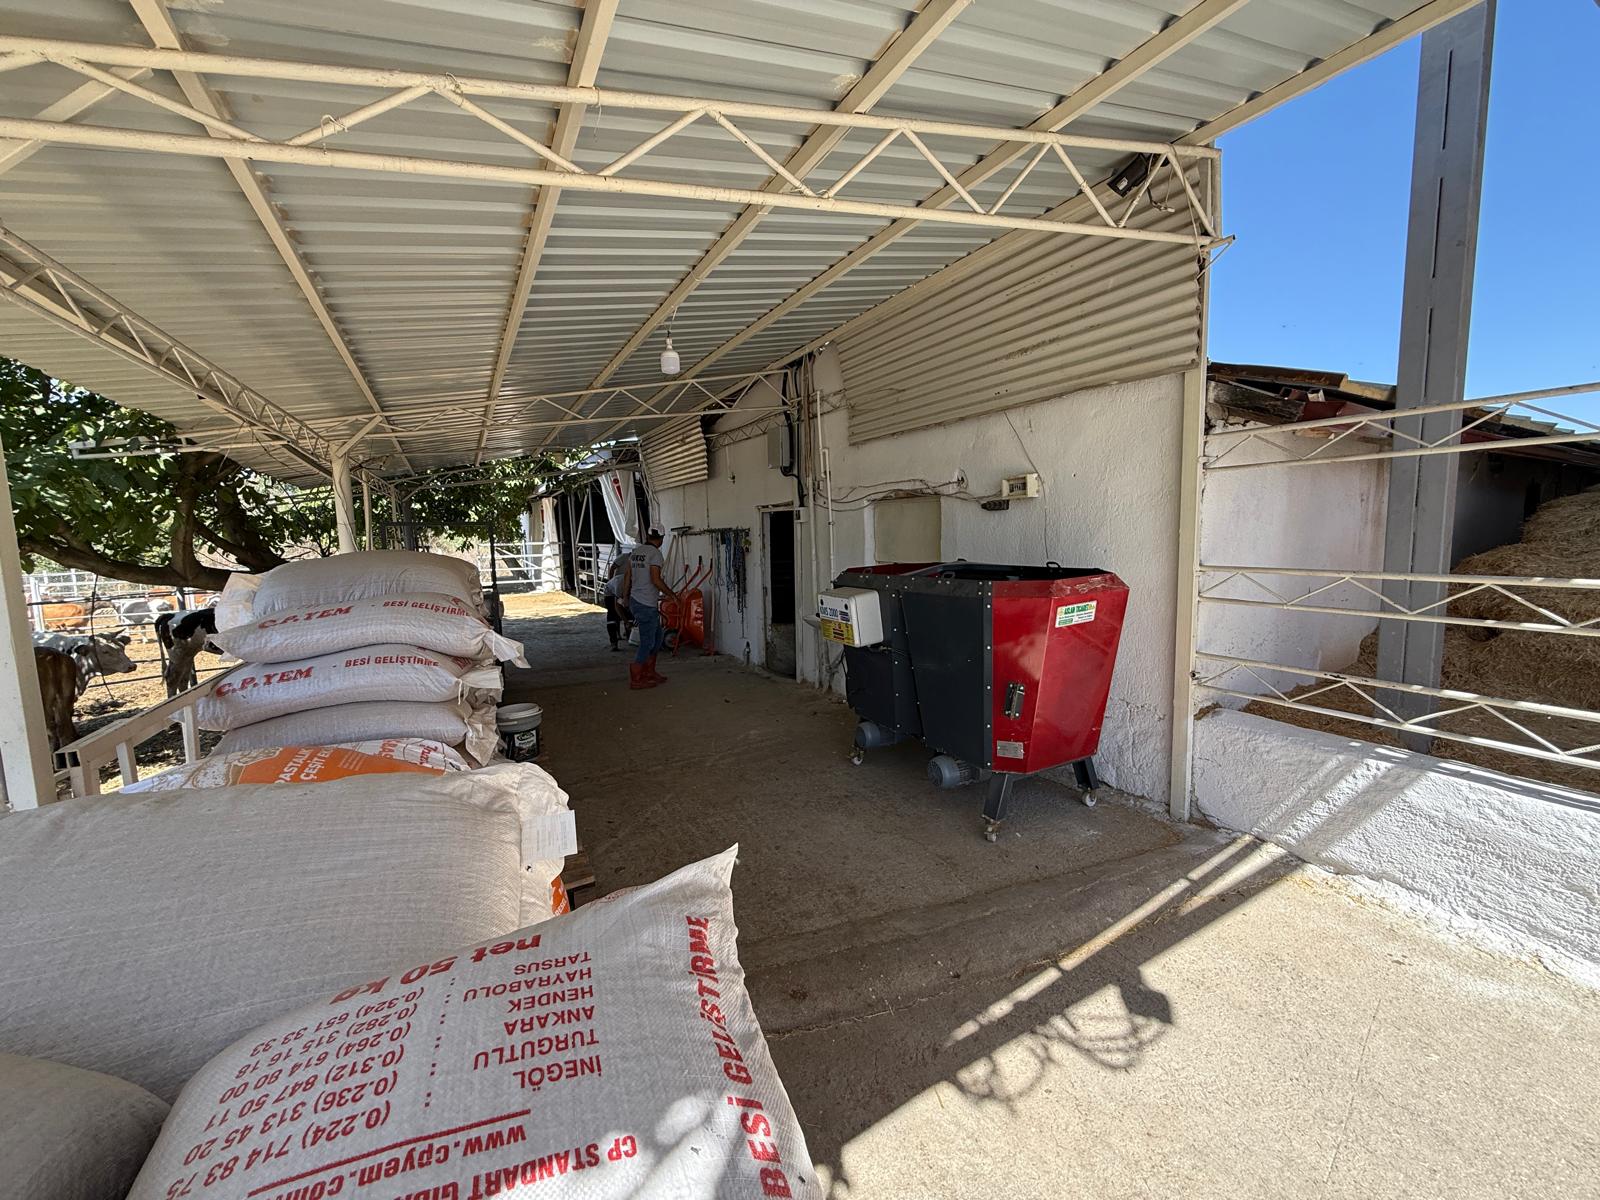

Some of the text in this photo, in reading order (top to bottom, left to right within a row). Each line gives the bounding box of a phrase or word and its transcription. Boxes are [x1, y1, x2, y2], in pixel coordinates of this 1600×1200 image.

[383, 599, 409, 608] BESİ
[345, 655, 371, 668] BESİ
[471, 934, 542, 963] net
[400, 956, 459, 985] 50
[513, 952, 593, 975] TARSUS
[463, 967, 593, 1002] HAYRABOLU
[507, 985, 594, 1013] HENDEK
[357, 987, 426, 1019] (0.324)
[313, 1012, 349, 1032] 651
[347, 1003, 418, 1037] (0.282)
[503, 1005, 596, 1036] ANKARA
[250, 1038, 275, 1058] 33
[281, 1026, 309, 1047] 33
[301, 1028, 341, 1049] 315
[336, 1022, 412, 1059] (0.264)
[473, 1028, 600, 1070] TURGUTLU
[235, 1059, 260, 1080] 18
[270, 1048, 293, 1067] 16
[288, 1051, 328, 1078] 614
[325, 1044, 405, 1085] (0.312)
[686, 915, 793, 1199] BESİ GELİŞTİRME
[253, 1068, 282, 1090] 80
[512, 1055, 602, 1092] İNEGÖL
[219, 1082, 249, 1105] 00
[272, 1074, 319, 1106] 847
[313, 1071, 399, 1114] (0.236)
[204, 1108, 232, 1133] 11
[238, 1098, 269, 1120] 50
[261, 1101, 307, 1135] 313
[302, 1100, 392, 1148] (0.224)
[184, 1137, 218, 1166] 20
[224, 1127, 252, 1151] 45
[244, 1134, 294, 1172] 714
[203, 1159, 241, 1188] 83
[393, 1134, 638, 1200] CP STANDART GID
[166, 1172, 199, 1200] 75
